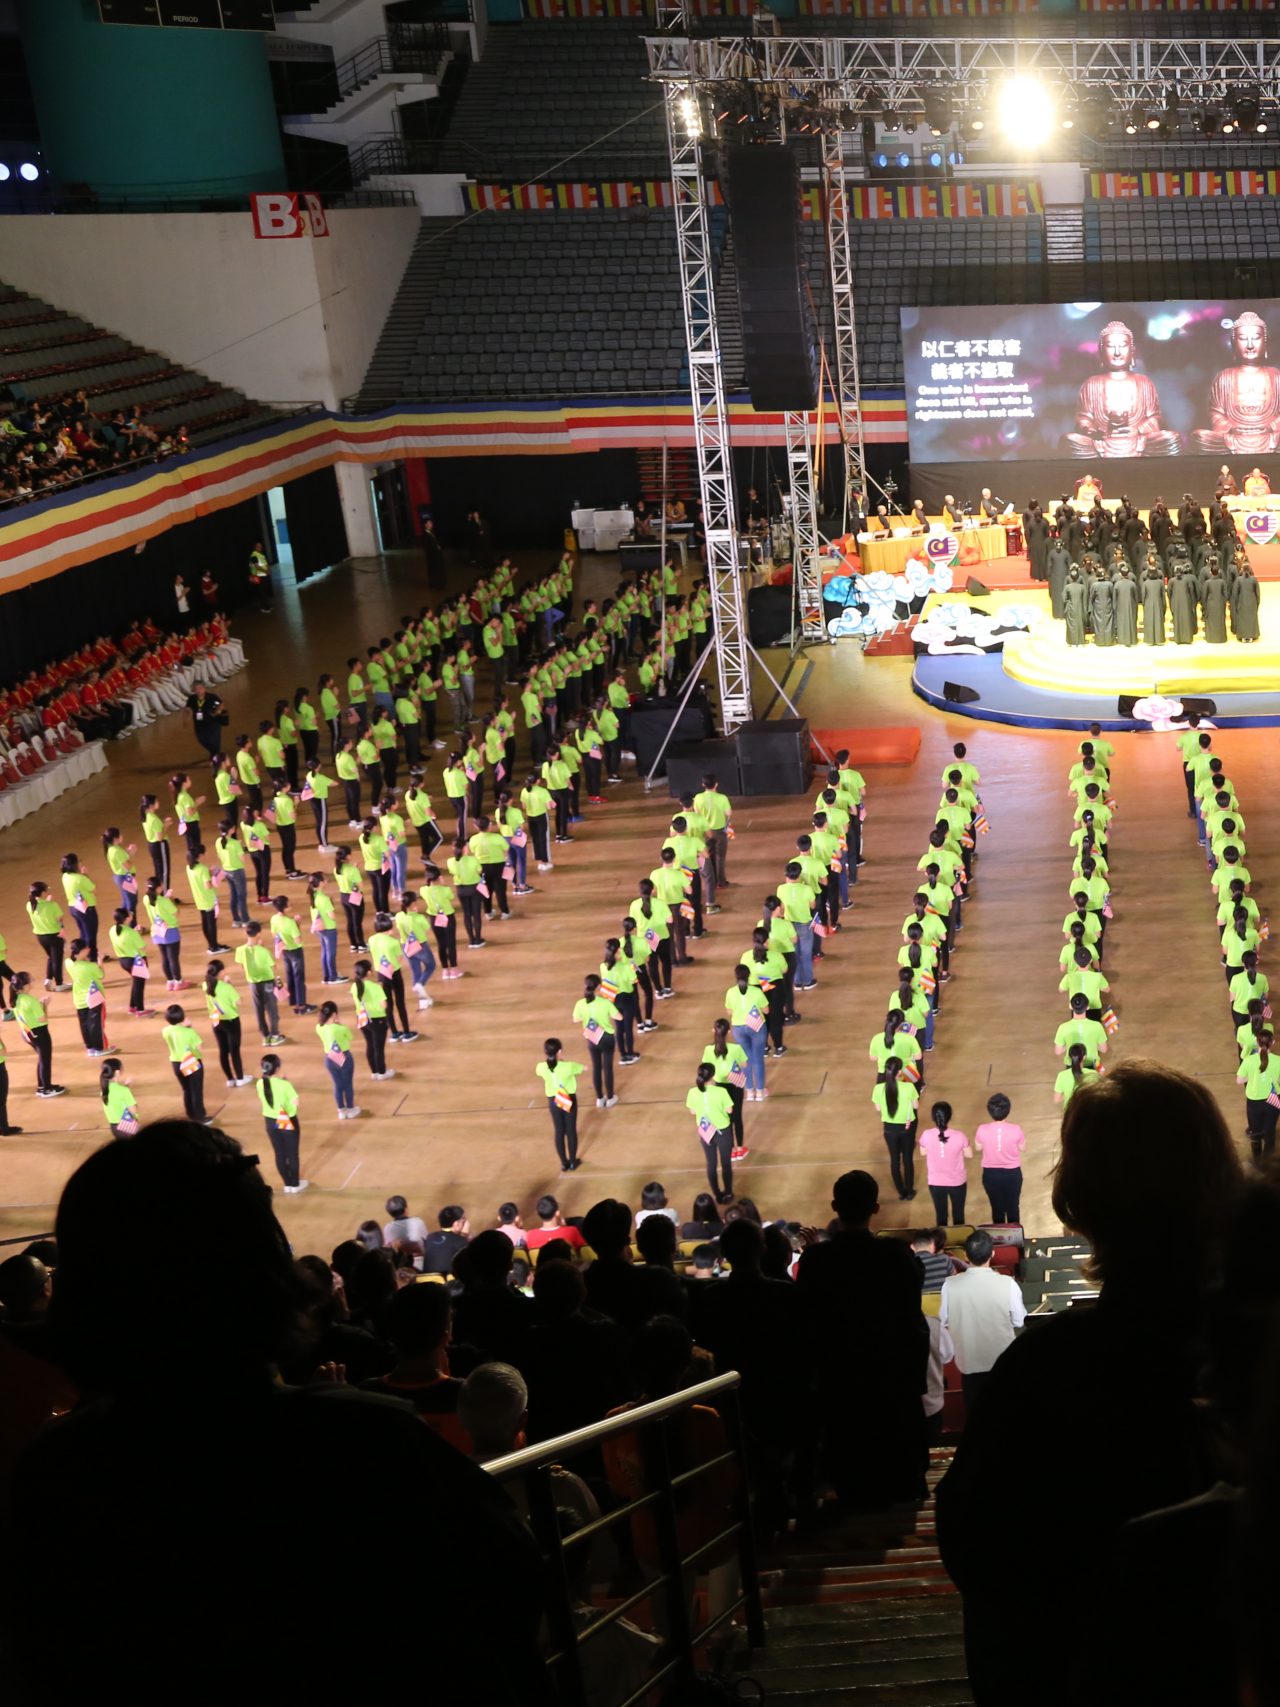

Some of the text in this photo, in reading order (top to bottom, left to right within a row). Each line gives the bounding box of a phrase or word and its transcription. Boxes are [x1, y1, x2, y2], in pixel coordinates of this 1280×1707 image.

[172, 15, 198, 23] PERIOD
[256, 194, 298, 237] B
[304, 194, 326, 236] B
[918, 385, 939, 395] One
